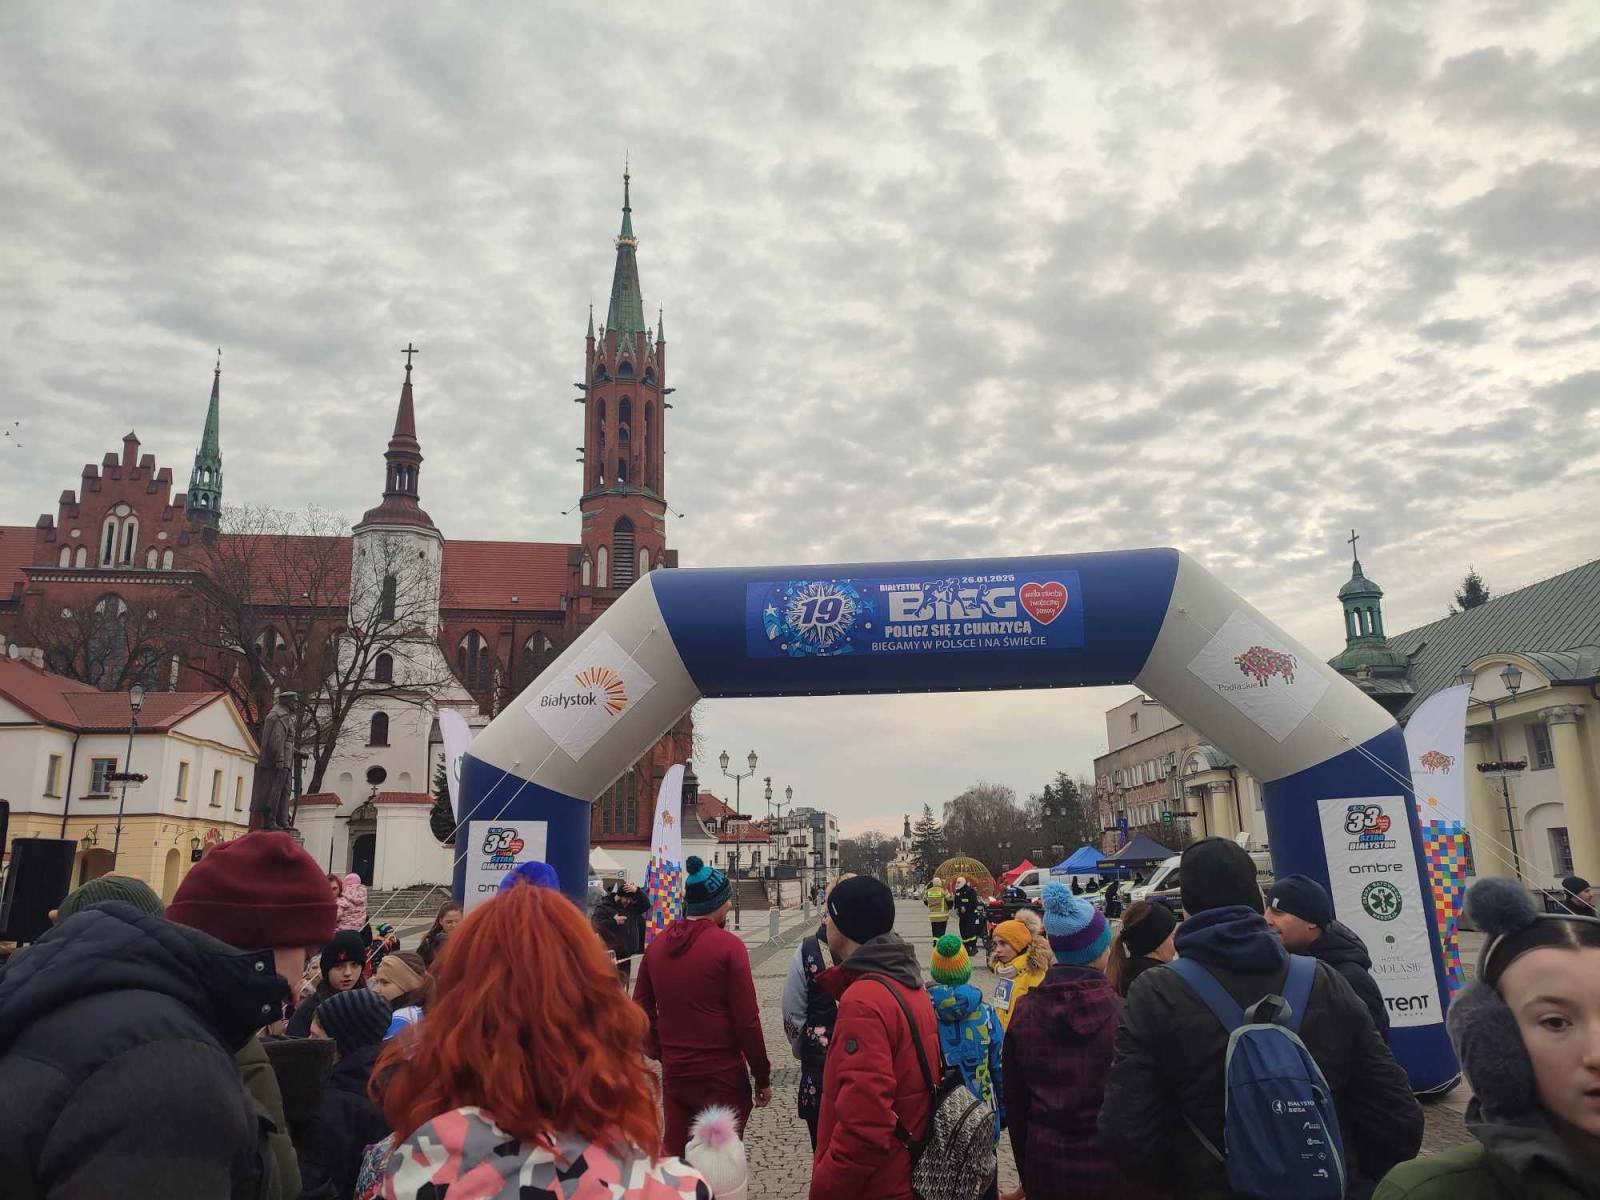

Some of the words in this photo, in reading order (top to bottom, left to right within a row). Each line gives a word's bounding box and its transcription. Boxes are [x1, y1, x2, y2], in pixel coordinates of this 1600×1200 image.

[962, 574, 1015, 584] 26.01.2025
[880, 583, 921, 592] BIAŁYSTOK
[802, 598, 843, 624] 19
[889, 587, 1017, 622] BIEG
[885, 624, 929, 638] POLICZ
[931, 623, 951, 638] SIĘ
[953, 623, 961, 636] Z
[963, 621, 1032, 635] CUKRZYCĄ
[871, 640, 921, 651] BIEGAMY
[922, 640, 934, 649] W
[936, 638, 976, 649] POLSCE
[984, 637, 1001, 647] NA
[1003, 635, 1048, 647] ŚWIECIE
[1218, 681, 1258, 692] Podlaskie
[540, 691, 597, 709] Białystok
[1345, 805, 1382, 834] 33
[483, 828, 518, 854] 33
[1348, 840, 1396, 850] BIAŁYSTOK
[481, 862, 516, 870] BIAŁYST
[1349, 863, 1403, 874] ombre
[1371, 960, 1421, 974] ODLASIE
